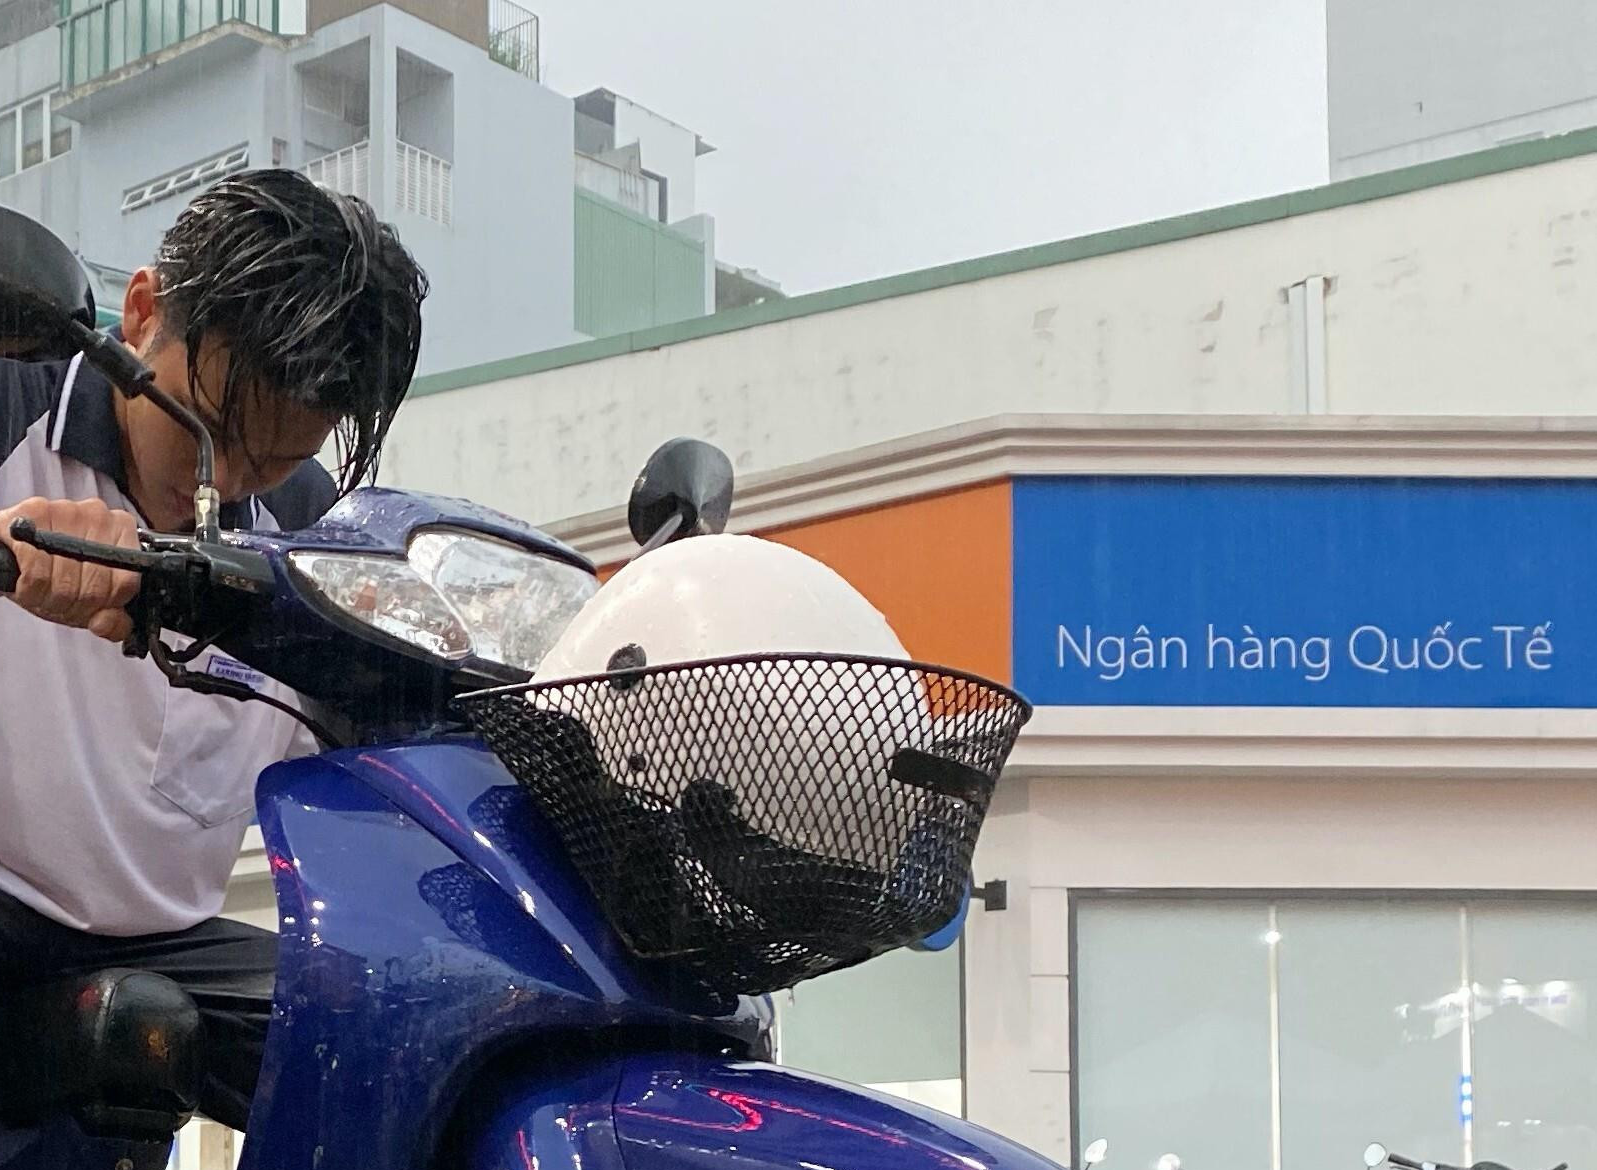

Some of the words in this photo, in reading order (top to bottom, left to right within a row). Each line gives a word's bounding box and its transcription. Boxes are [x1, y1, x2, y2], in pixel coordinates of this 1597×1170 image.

[1056, 624, 1189, 681] Ngân
[1207, 623, 1333, 682] hàng
[1348, 620, 1484, 675] Quốc
[1491, 620, 1555, 671] Tế
